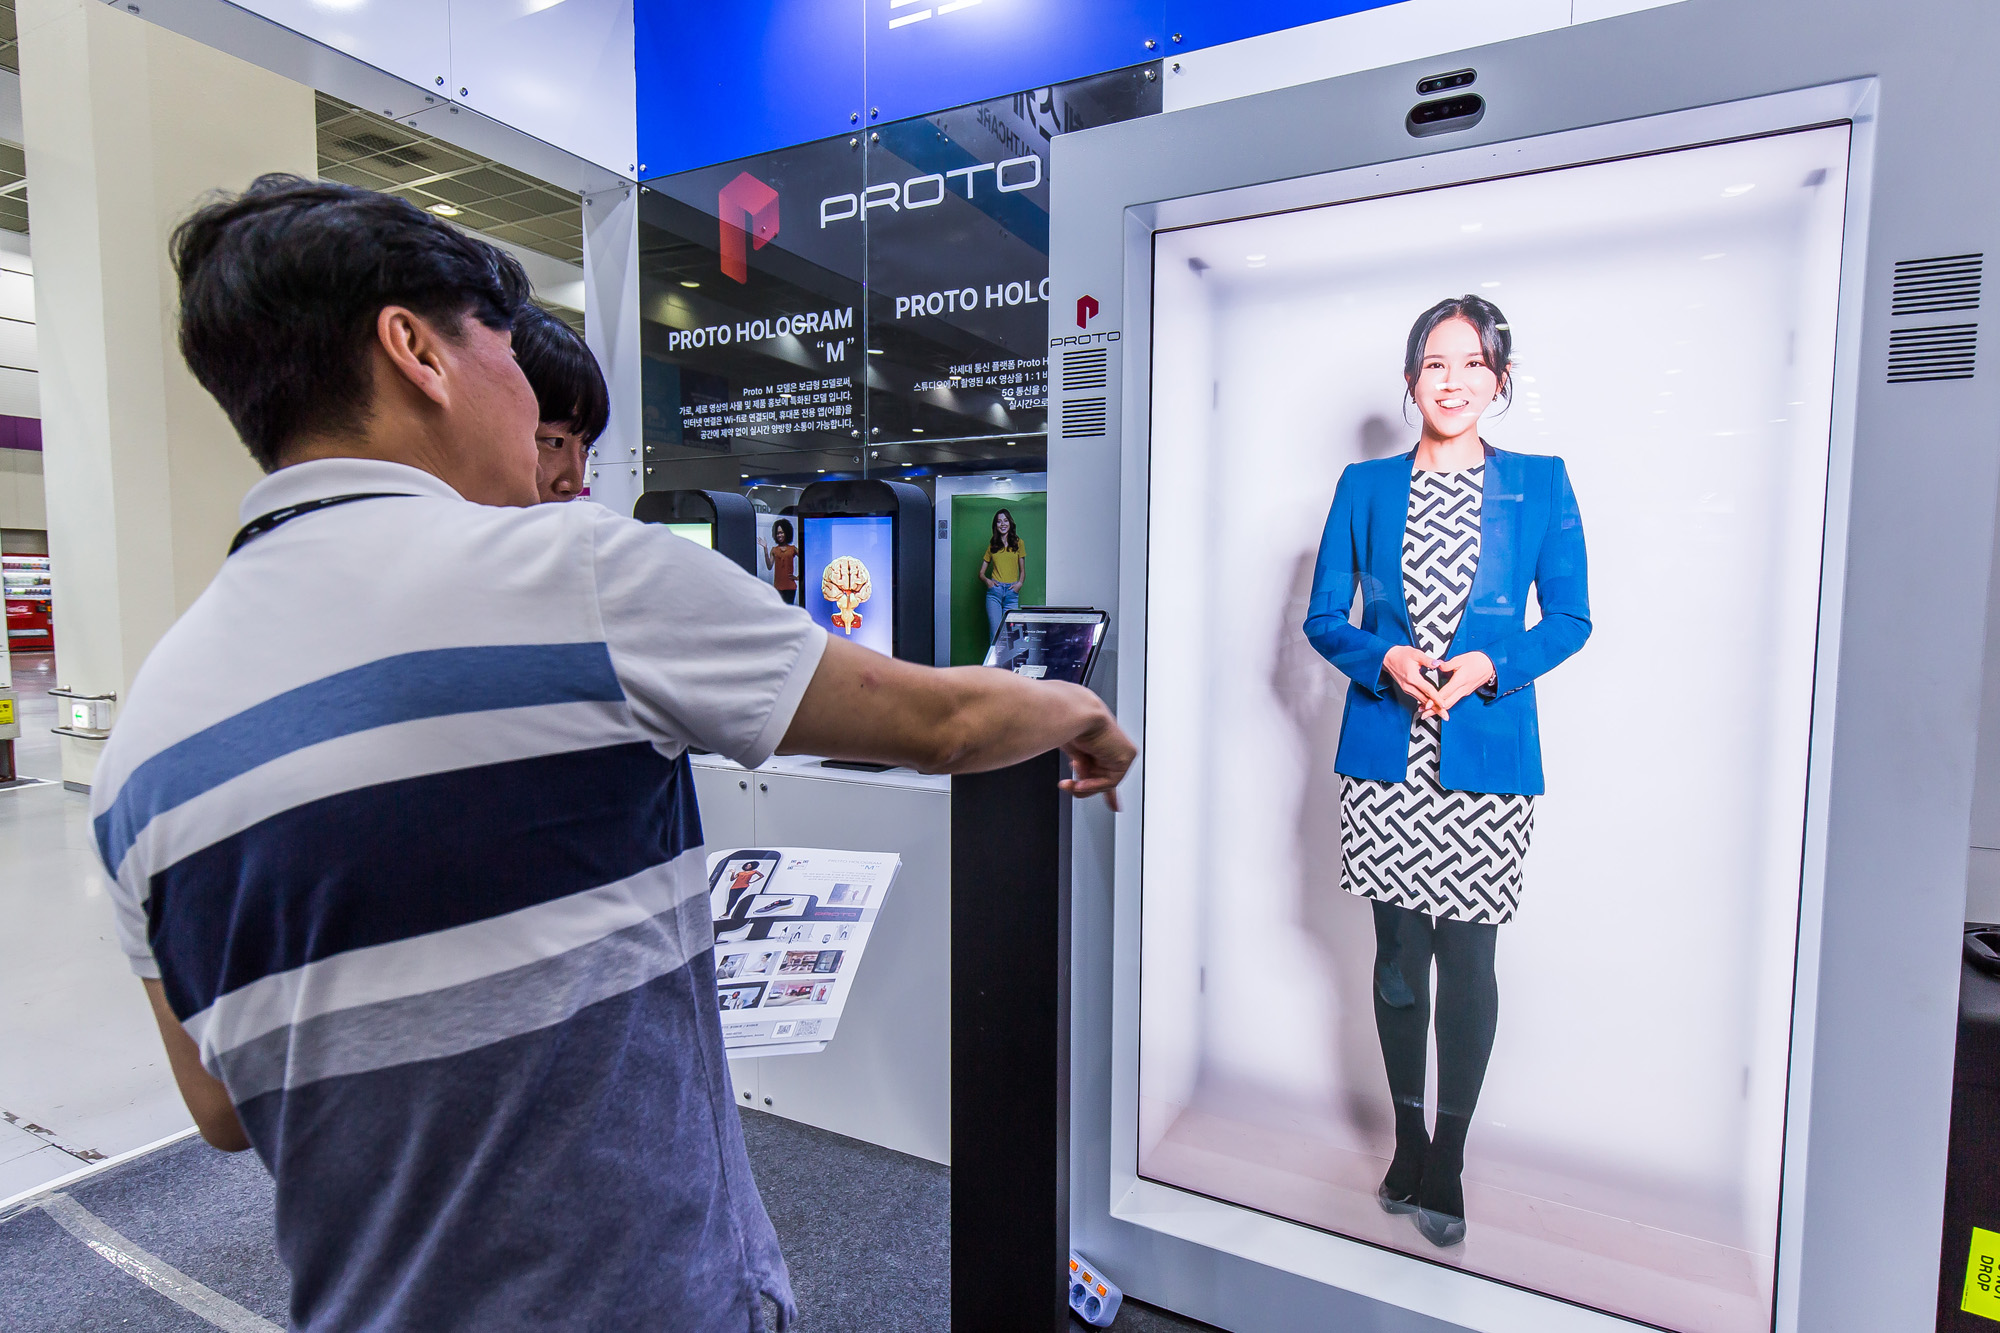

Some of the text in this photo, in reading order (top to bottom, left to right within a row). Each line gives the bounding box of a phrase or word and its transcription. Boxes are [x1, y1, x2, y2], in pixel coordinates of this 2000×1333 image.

[820, 154, 1042, 229] PROTO
[895, 287, 978, 319] PROTO
[669, 307, 854, 351] PROTO HOLOGRAM
[1050, 331, 1121, 348] PROTO
[949, 363, 973, 375] 차세대
[974, 362, 990, 373] 통신
[992, 359, 1015, 371] 플랫폼
[1017, 358, 1041, 369] Proto
[743, 387, 763, 397] Proto
[765, 386, 774, 394] M
[776, 382, 797, 394] 모델은
[798, 380, 820, 392] 보급형
[913, 380, 959, 392] 스튜디오에서
[961, 377, 984, 389] 촬영된
[985, 375, 997, 385] 4K
[999, 372, 1023, 384] 영상을
[1001, 388, 1014, 397] 5G
[1015, 384, 1040, 396] 통신을
[695, 404, 708, 414] 세로
[709, 402, 728, 413] 영상의
[729, 400, 743, 411] 사물
[744, 400, 751, 410] 및
[752, 399, 766, 409] 제품
[812, 393, 827, 404] 모델
[828, 391, 853, 403] 입니다.
[683, 418, 702, 428] 인터넷
[703, 415, 722, 427] 연결은
[779, 408, 800, 420] 휴대폰
[801, 407, 816, 418] 전용
[700, 418, 854, 440] 공간에 제약 없이 실시간 양방향 소통이 가능합니다.
[1977, 1255, 1994, 1292] DROP
